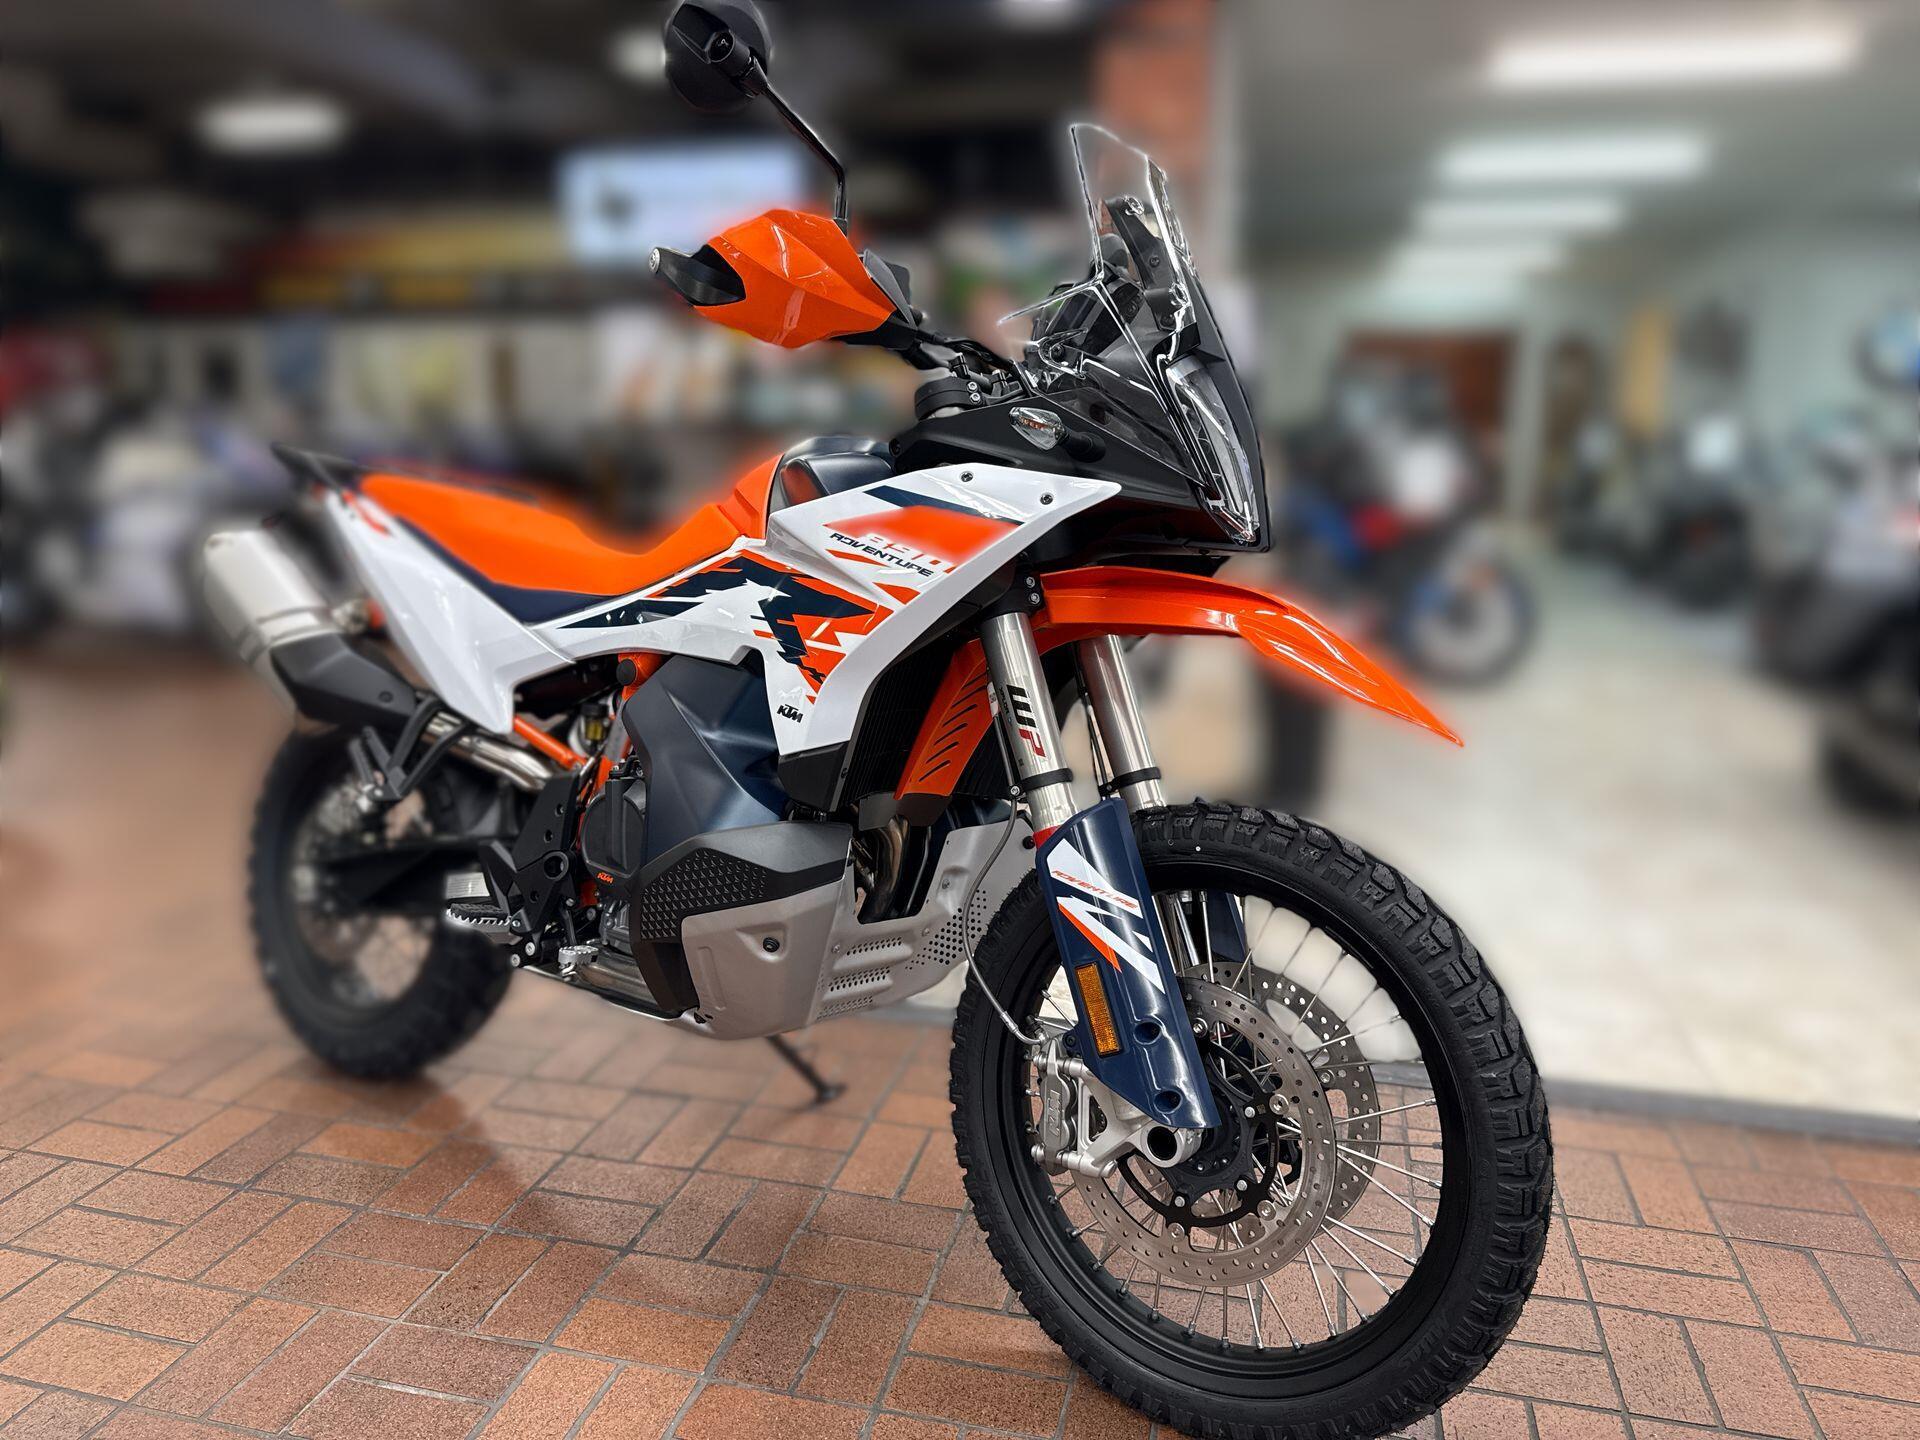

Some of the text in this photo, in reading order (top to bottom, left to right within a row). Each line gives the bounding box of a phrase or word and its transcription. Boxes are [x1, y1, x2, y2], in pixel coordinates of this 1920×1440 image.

[829, 532, 935, 577] ADVENTURE
[777, 704, 803, 723] KTM
[1006, 684, 1046, 757] WP
[597, 872, 613, 884] KTM
[1051, 870, 1138, 909] ADVENTURE
